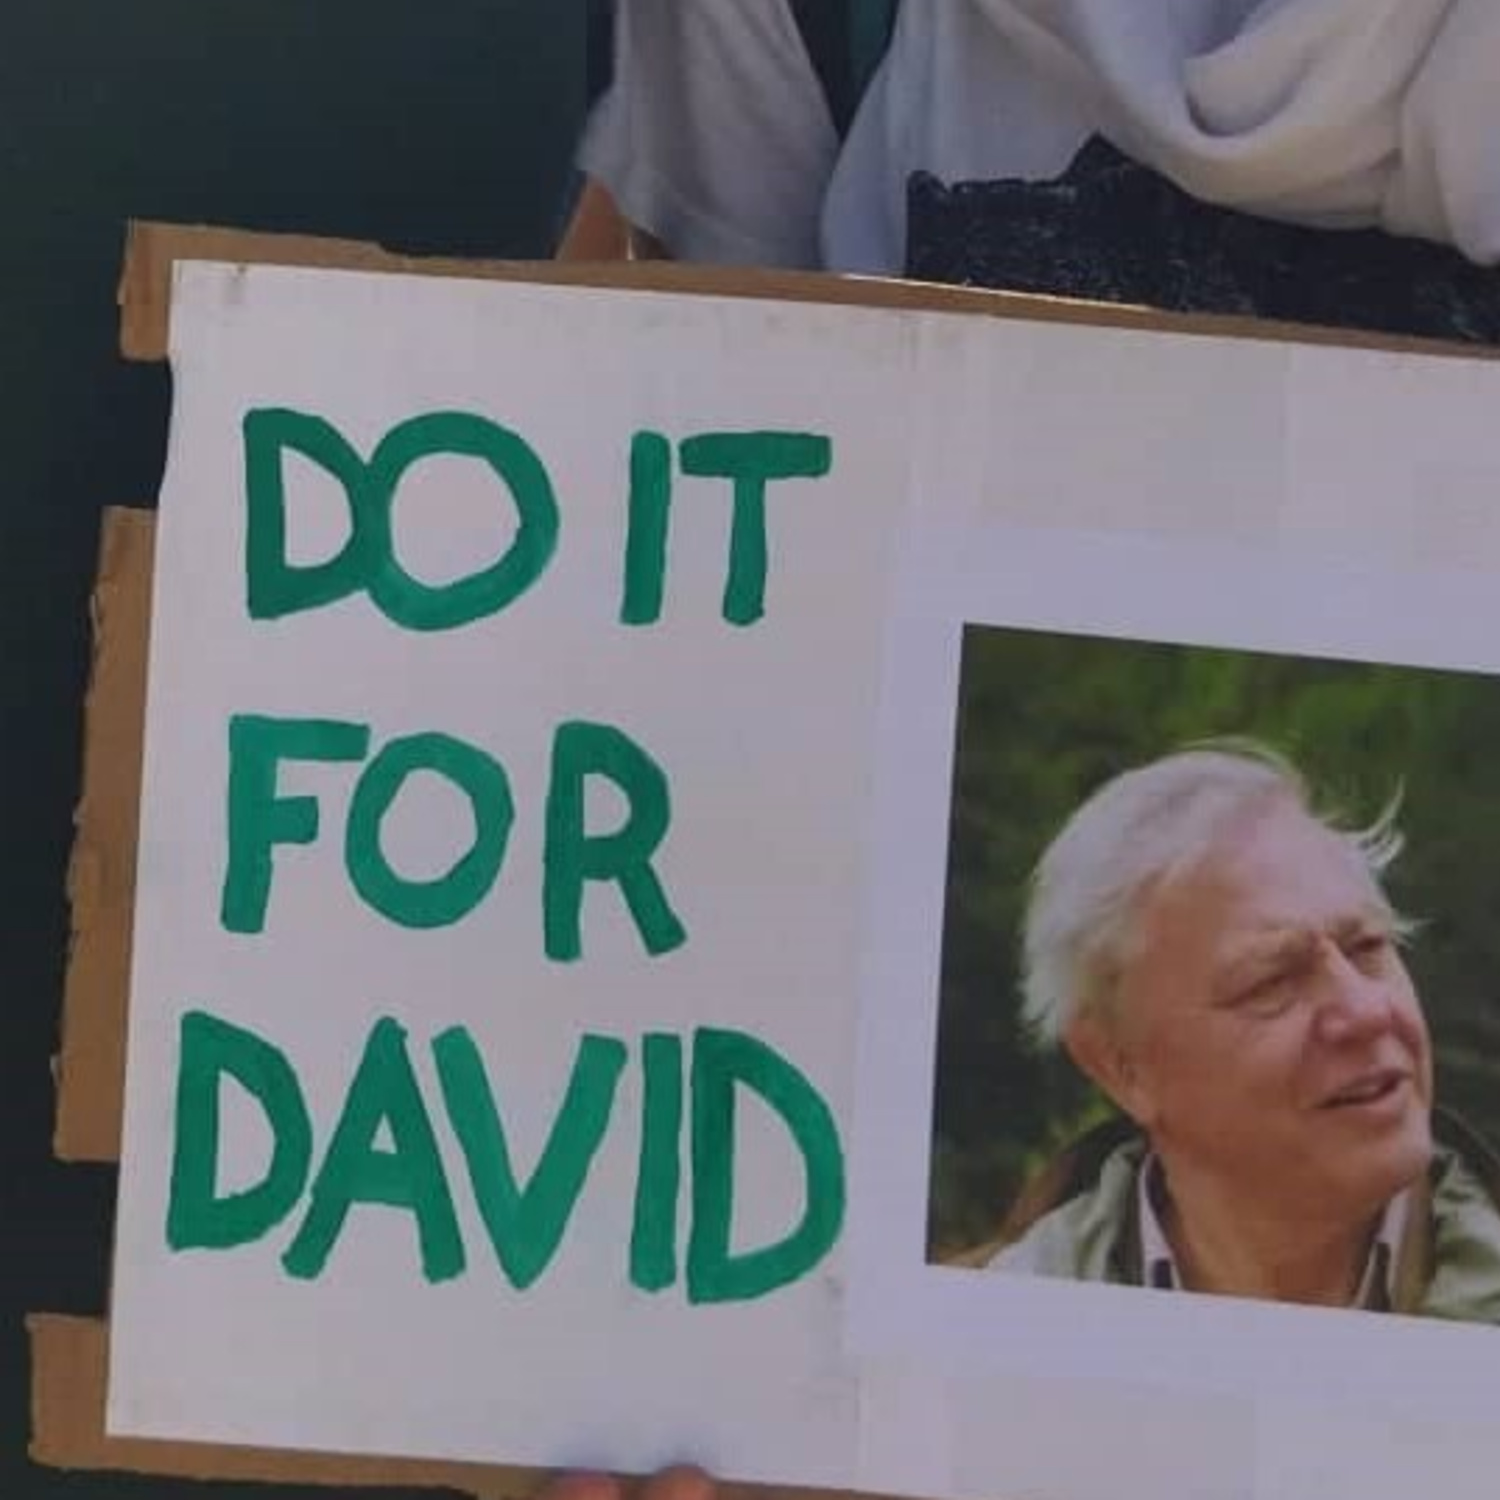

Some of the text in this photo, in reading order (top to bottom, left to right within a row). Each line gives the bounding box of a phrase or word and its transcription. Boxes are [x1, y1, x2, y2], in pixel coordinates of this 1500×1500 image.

[242, 406, 832, 631] DO IT
[221, 713, 687, 963] FOR
[166, 1009, 847, 1305] DAVID
